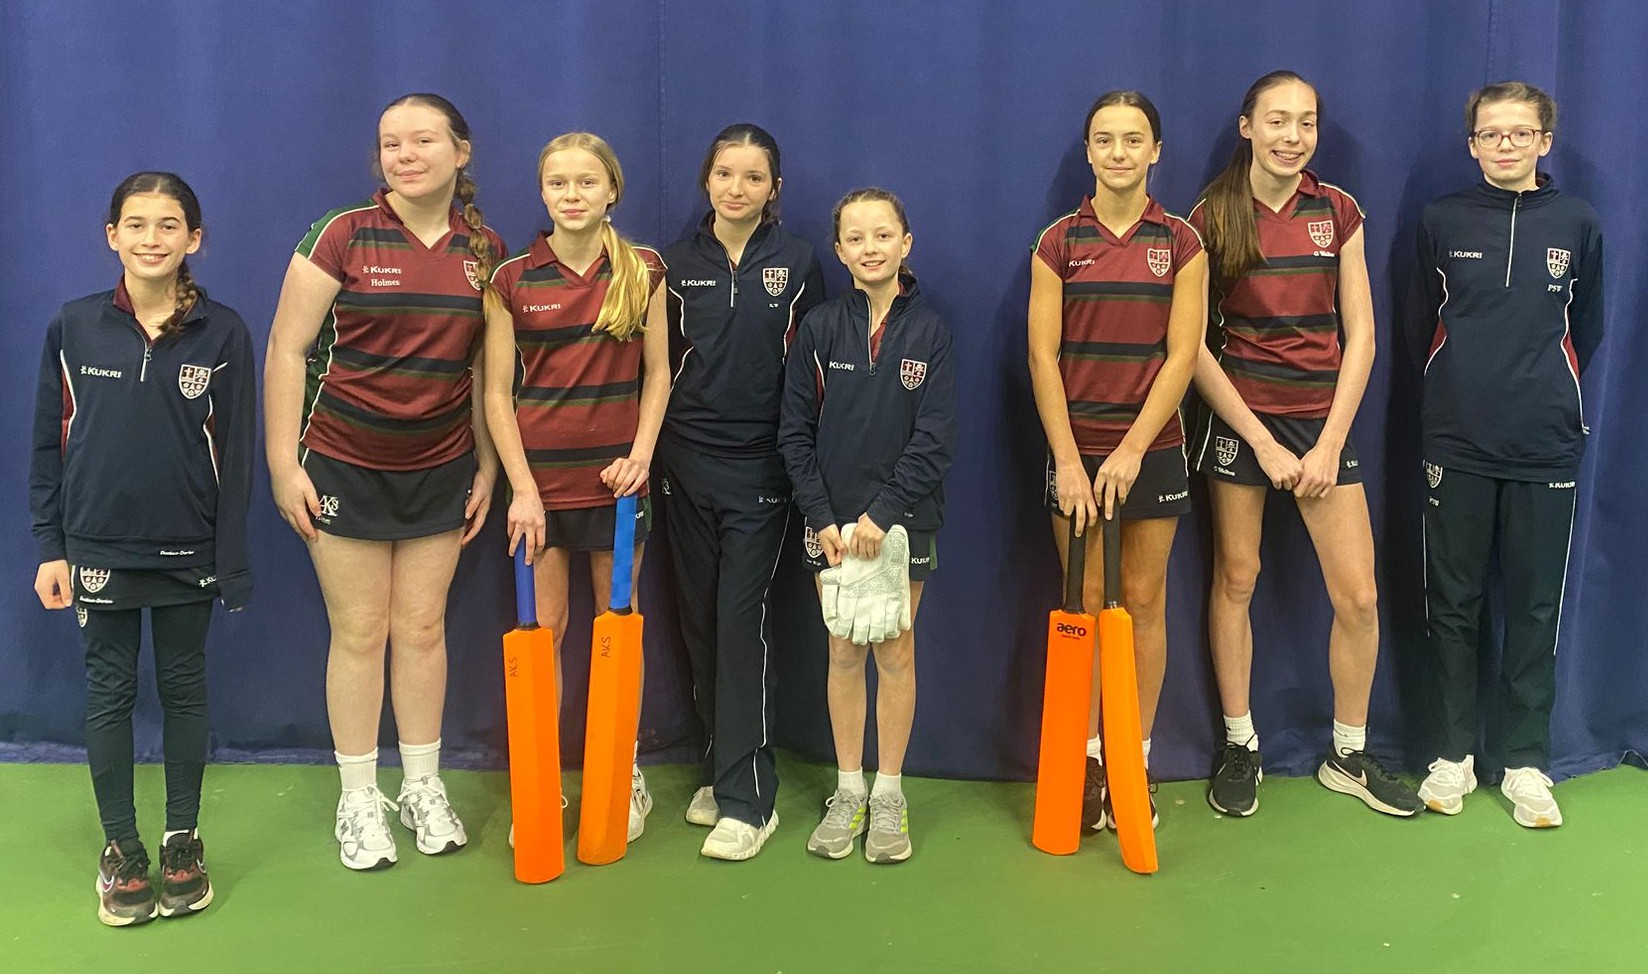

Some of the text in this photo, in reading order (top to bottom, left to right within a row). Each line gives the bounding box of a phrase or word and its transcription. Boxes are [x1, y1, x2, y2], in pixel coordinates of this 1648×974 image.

[1453, 250, 1483, 259] KUKRI
[1068, 258, 1096, 267] KUKRI
[370, 265, 402, 275] KUKRI
[371, 279, 400, 287] Holmes
[529, 303, 561, 312] KUKRI
[829, 361, 855, 371] KUKRI
[87, 366, 122, 379] KUKRI
[1056, 622, 1087, 637] aero
[601, 636, 611, 658] AKS
[508, 656, 518, 678] AKS
